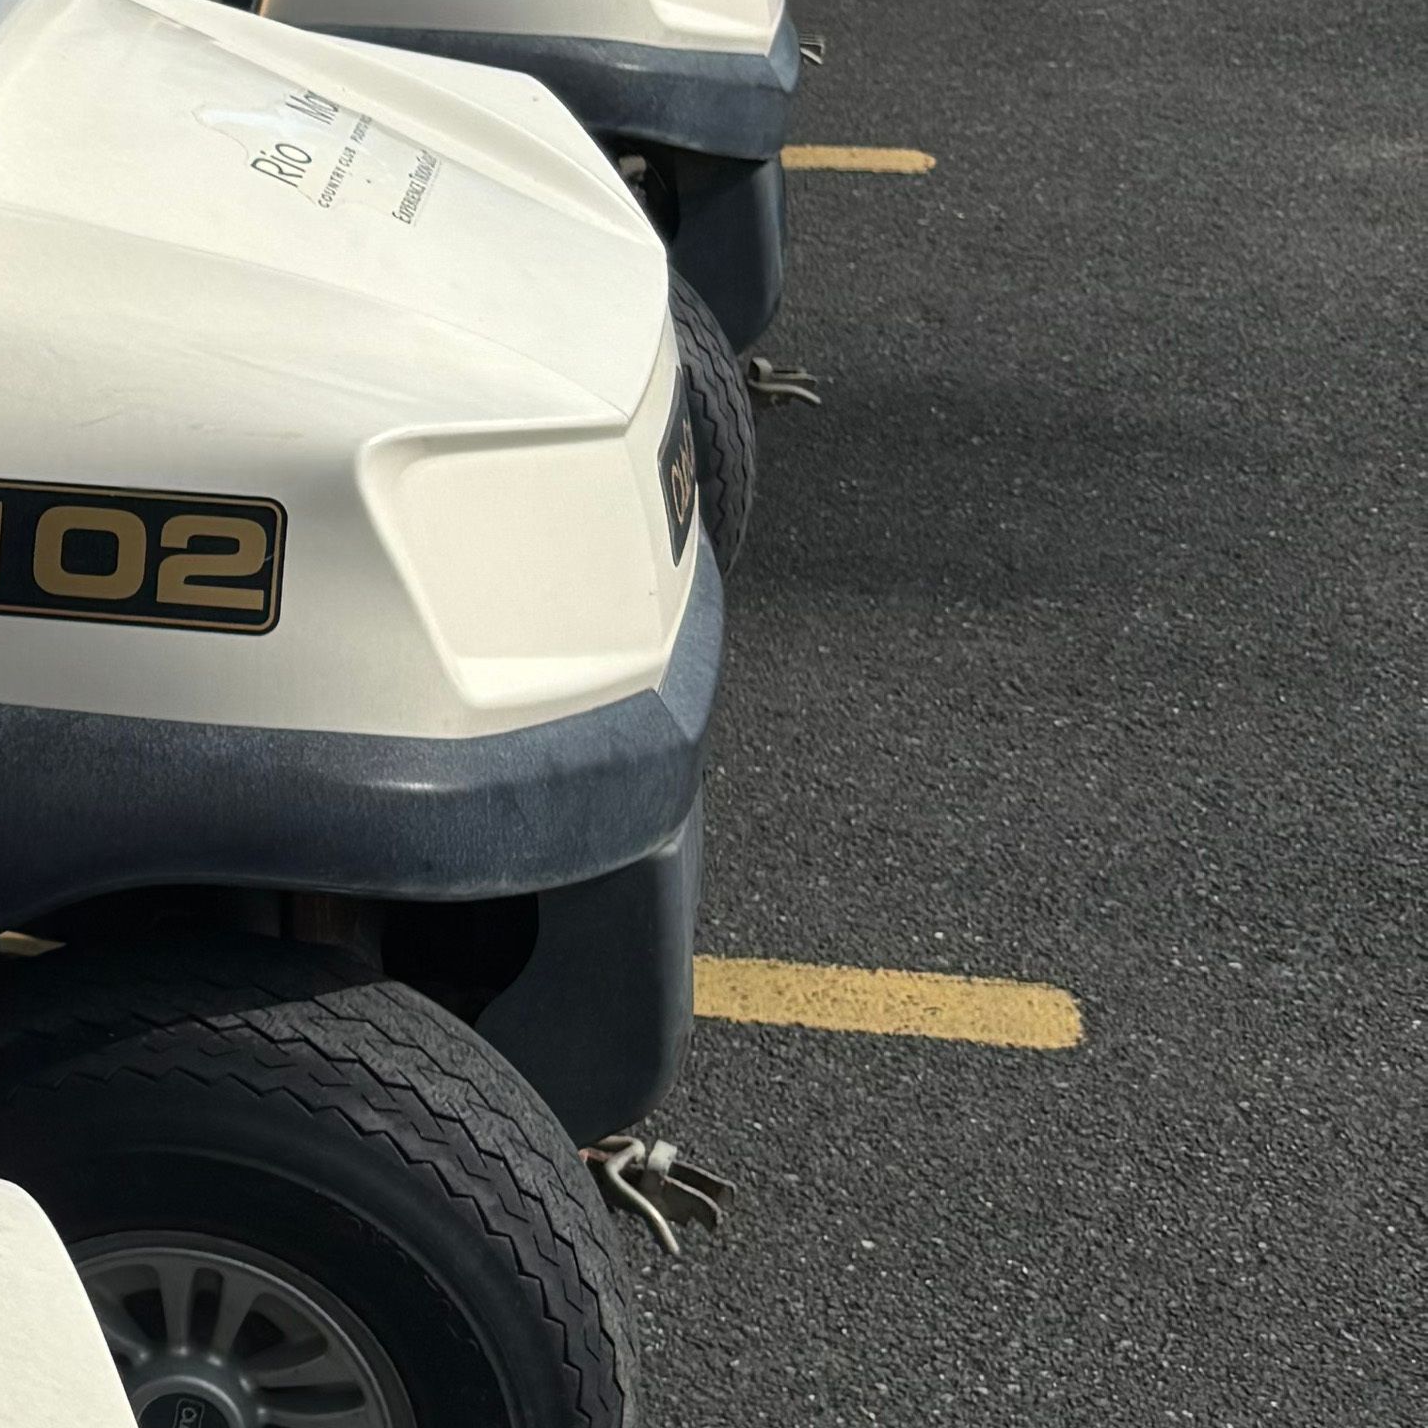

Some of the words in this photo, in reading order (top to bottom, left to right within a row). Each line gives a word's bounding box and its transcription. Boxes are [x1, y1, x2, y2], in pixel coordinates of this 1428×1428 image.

[250, 142, 313, 188] Rio
[285, 89, 339, 125] Ma
[317, 166, 347, 209] COUNTRY
